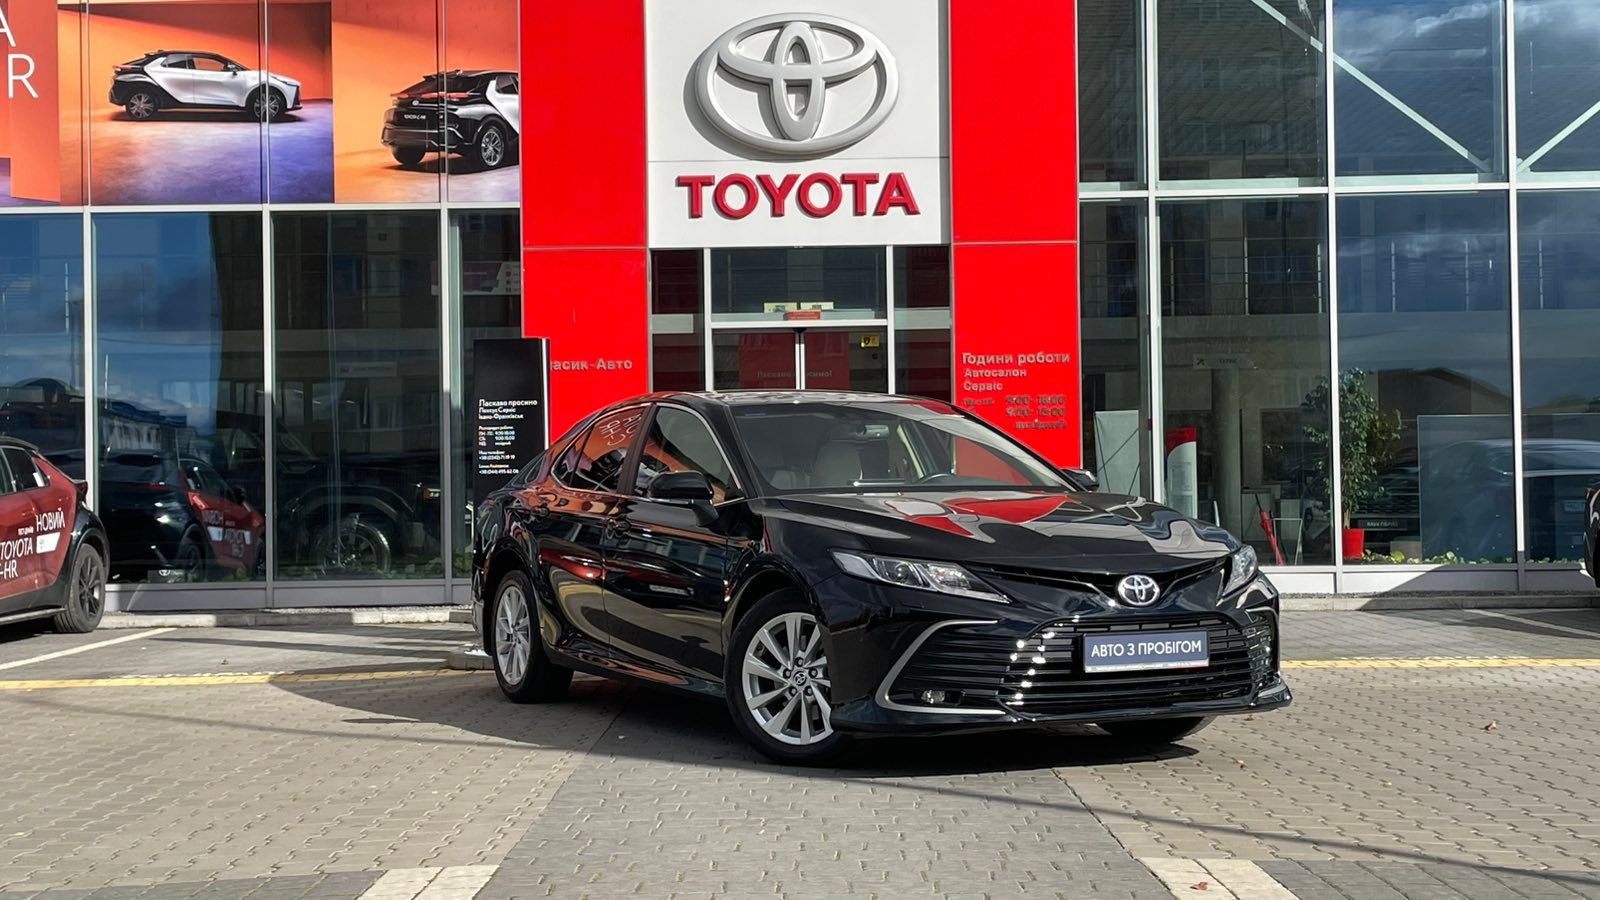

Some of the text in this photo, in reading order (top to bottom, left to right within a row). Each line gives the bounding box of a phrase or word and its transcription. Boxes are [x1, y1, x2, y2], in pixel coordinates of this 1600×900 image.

[676, 172, 921, 219] TOYOTA
[550, 358, 632, 370] асик-Авто
[962, 351, 1070, 366] Години роботи
[964, 368, 1027, 377] Автосалон
[963, 380, 1003, 392] Сервіс
[36, 509, 66, 532] НОВИЙ
[0, 537, 33, 560] TOYOTA
[0, 560, 18, 579] -HR
[1091, 643, 1125, 657] АВТО
[1138, 640, 1202, 655] ПРОБІГОМ
